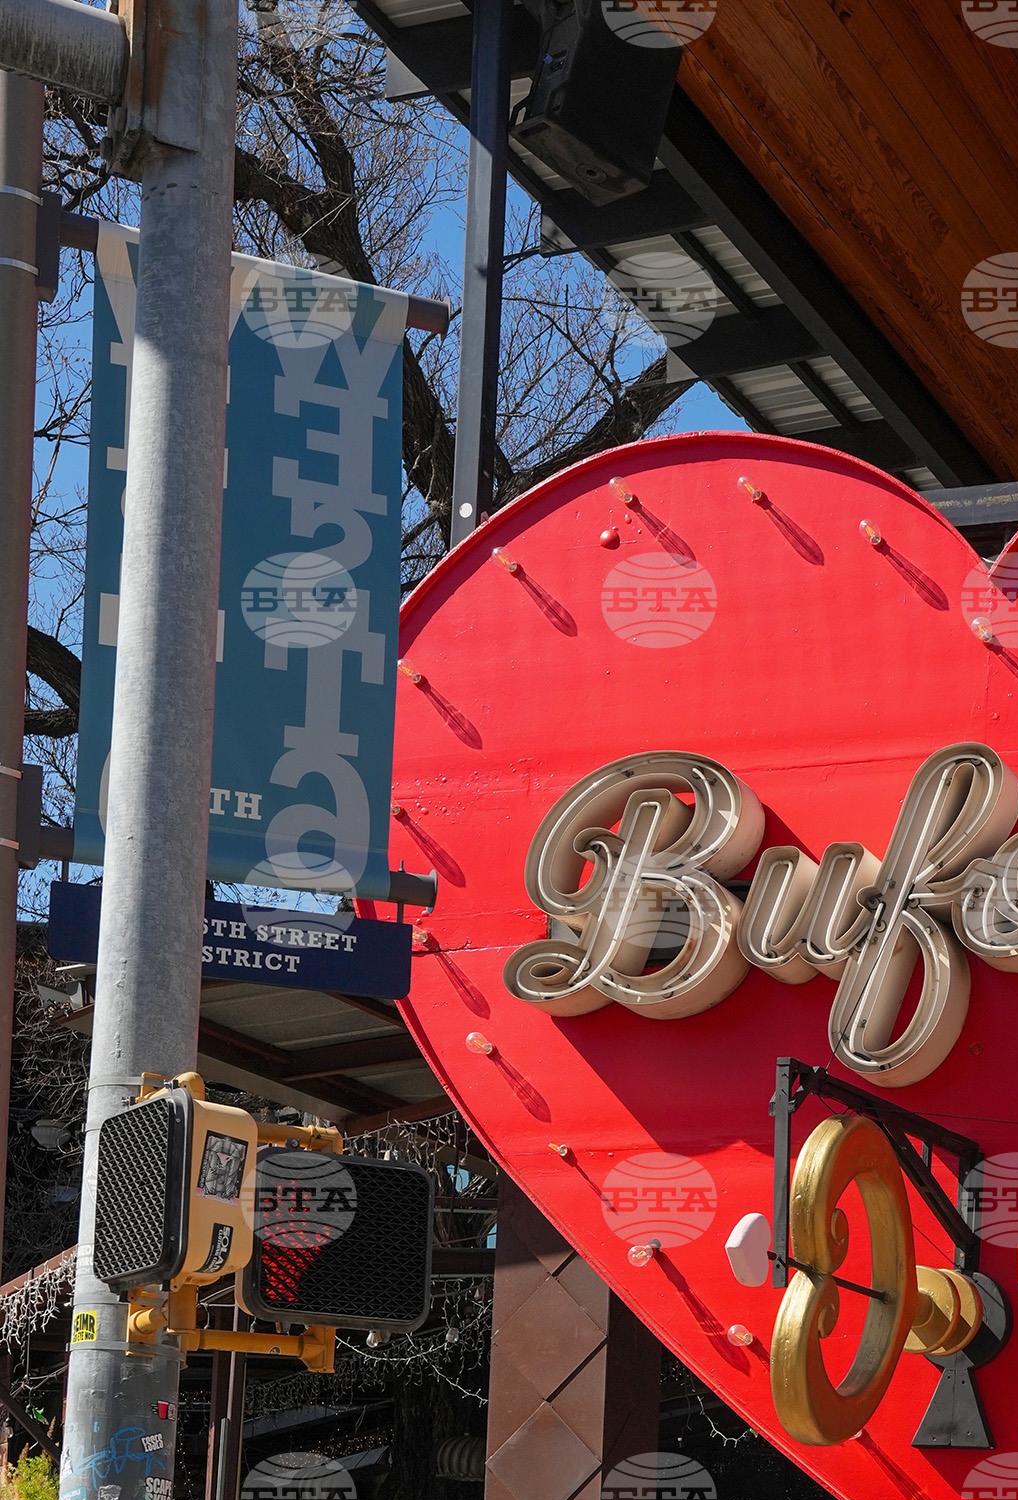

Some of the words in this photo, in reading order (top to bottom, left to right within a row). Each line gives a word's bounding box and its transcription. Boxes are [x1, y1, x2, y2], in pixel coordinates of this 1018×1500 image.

[257, 925, 358, 953] STREET
[202, 946, 300, 973] STRICT
[141, 1434, 164, 1453] ESSES
